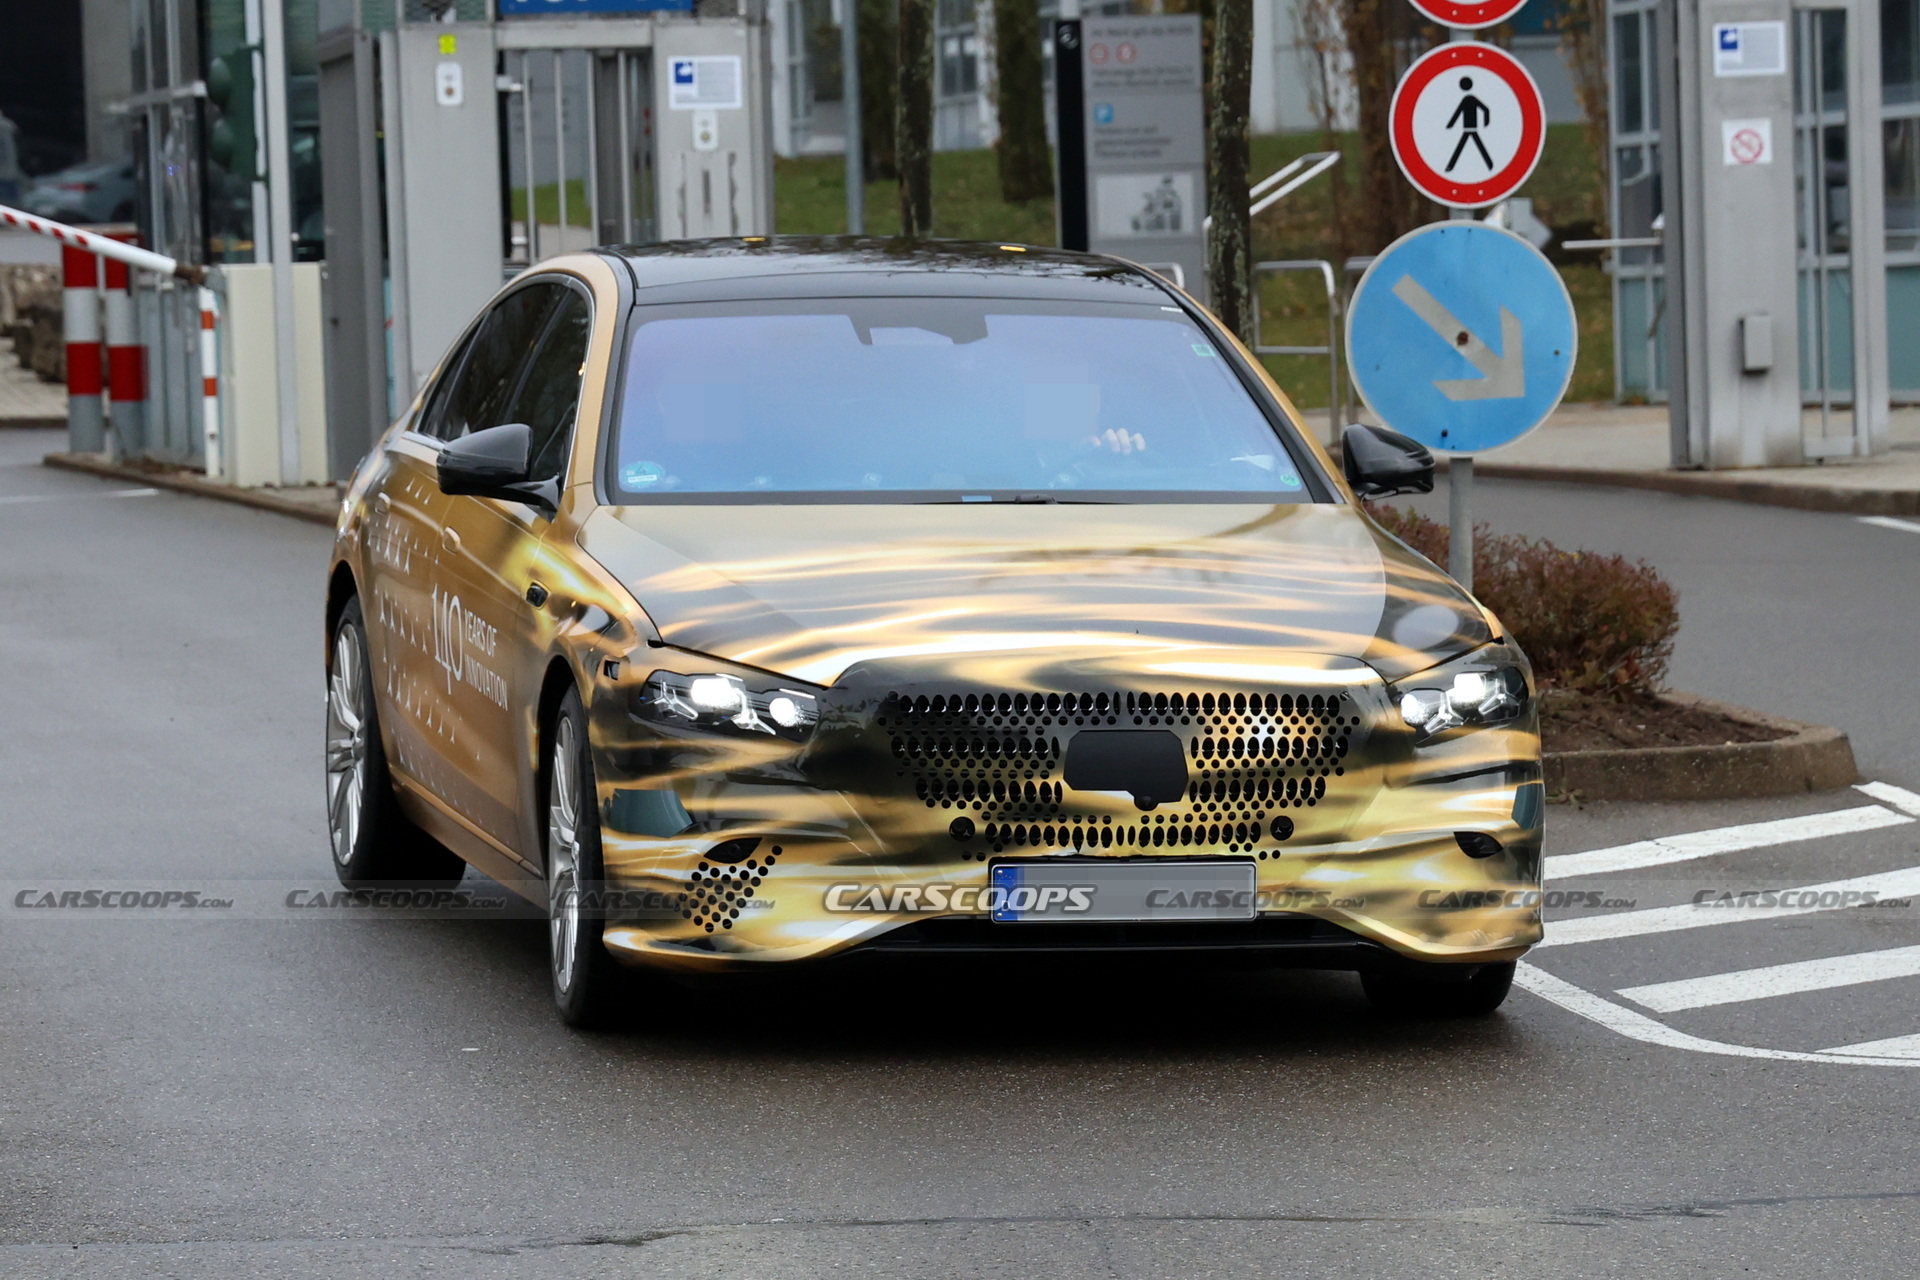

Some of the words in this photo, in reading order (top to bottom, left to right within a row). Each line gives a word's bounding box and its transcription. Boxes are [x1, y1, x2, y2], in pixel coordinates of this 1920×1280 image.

[432, 583, 462, 695] 140
[464, 608, 486, 652] YEARS
[486, 624, 498, 658] OF
[464, 653, 509, 712] INNOVATION
